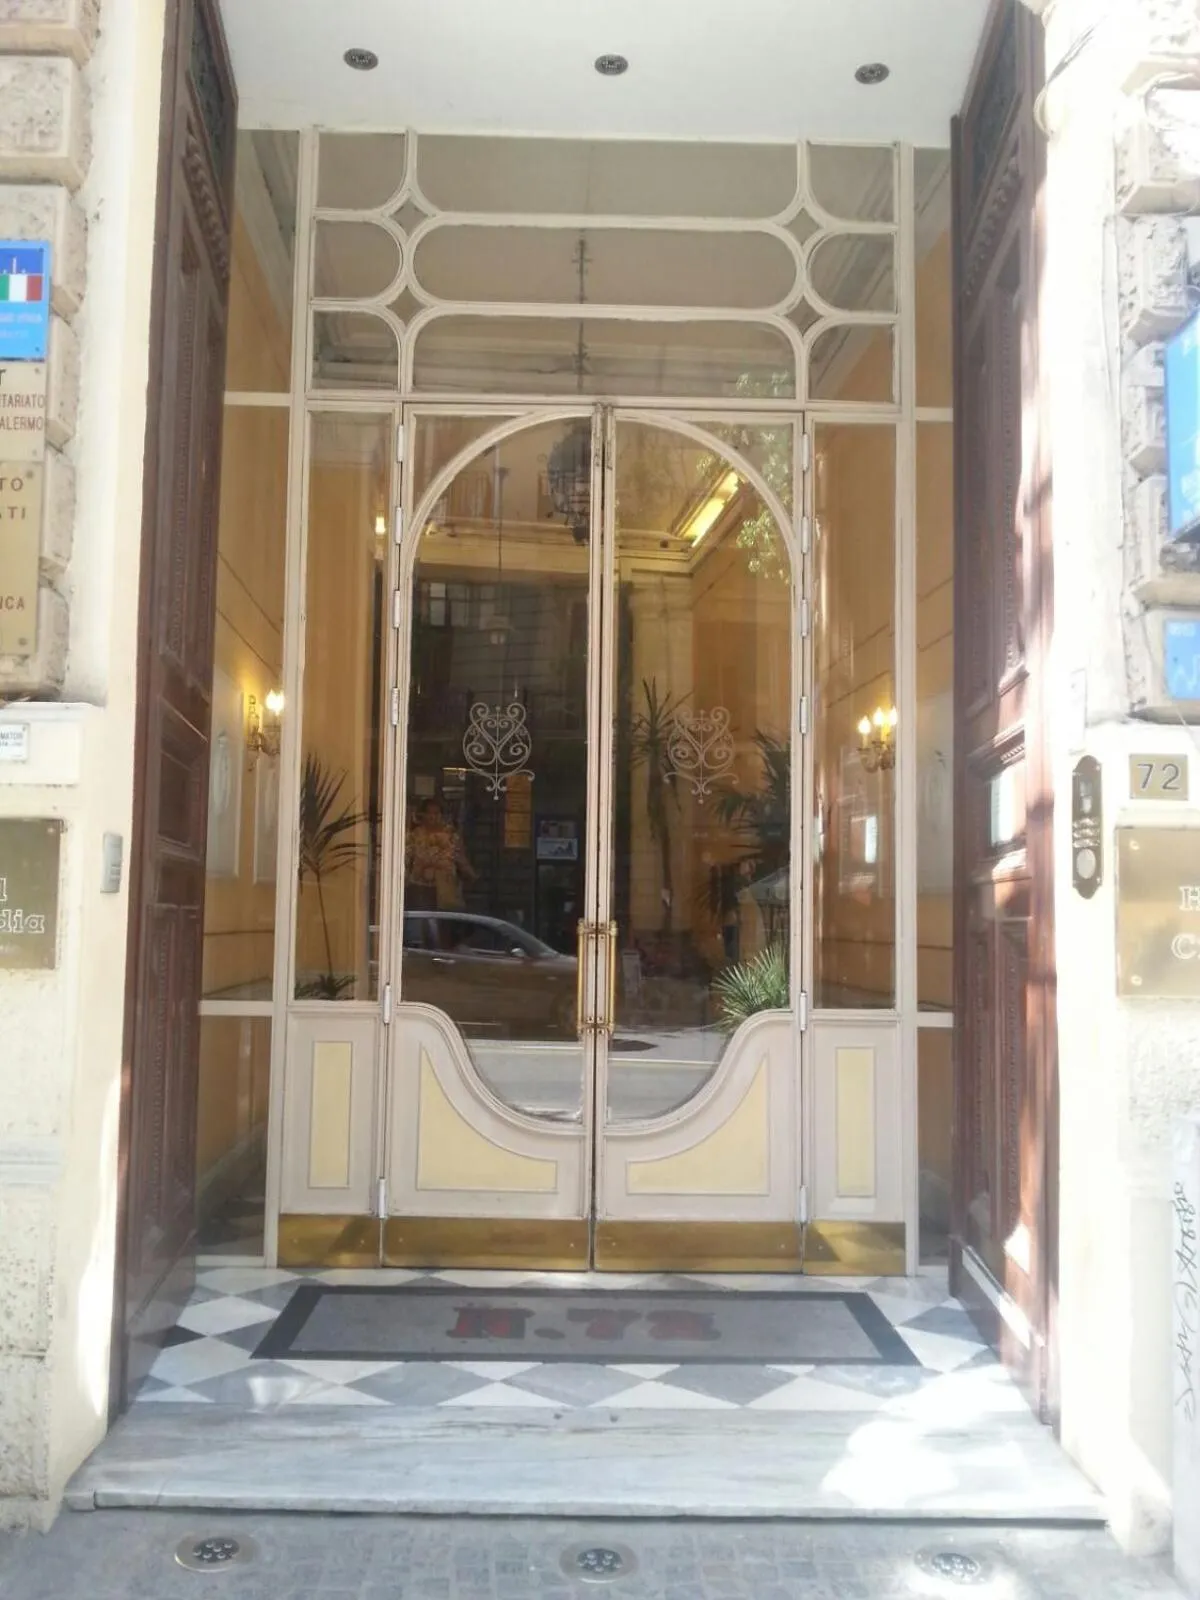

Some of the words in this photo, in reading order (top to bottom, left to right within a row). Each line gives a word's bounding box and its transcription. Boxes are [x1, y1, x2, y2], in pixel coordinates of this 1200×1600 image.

[0, 393, 45, 409] TARIATO
[0, 506, 26, 520] TI
[1136, 763, 1181, 790] 72
[1171, 933, 1200, 960] C
